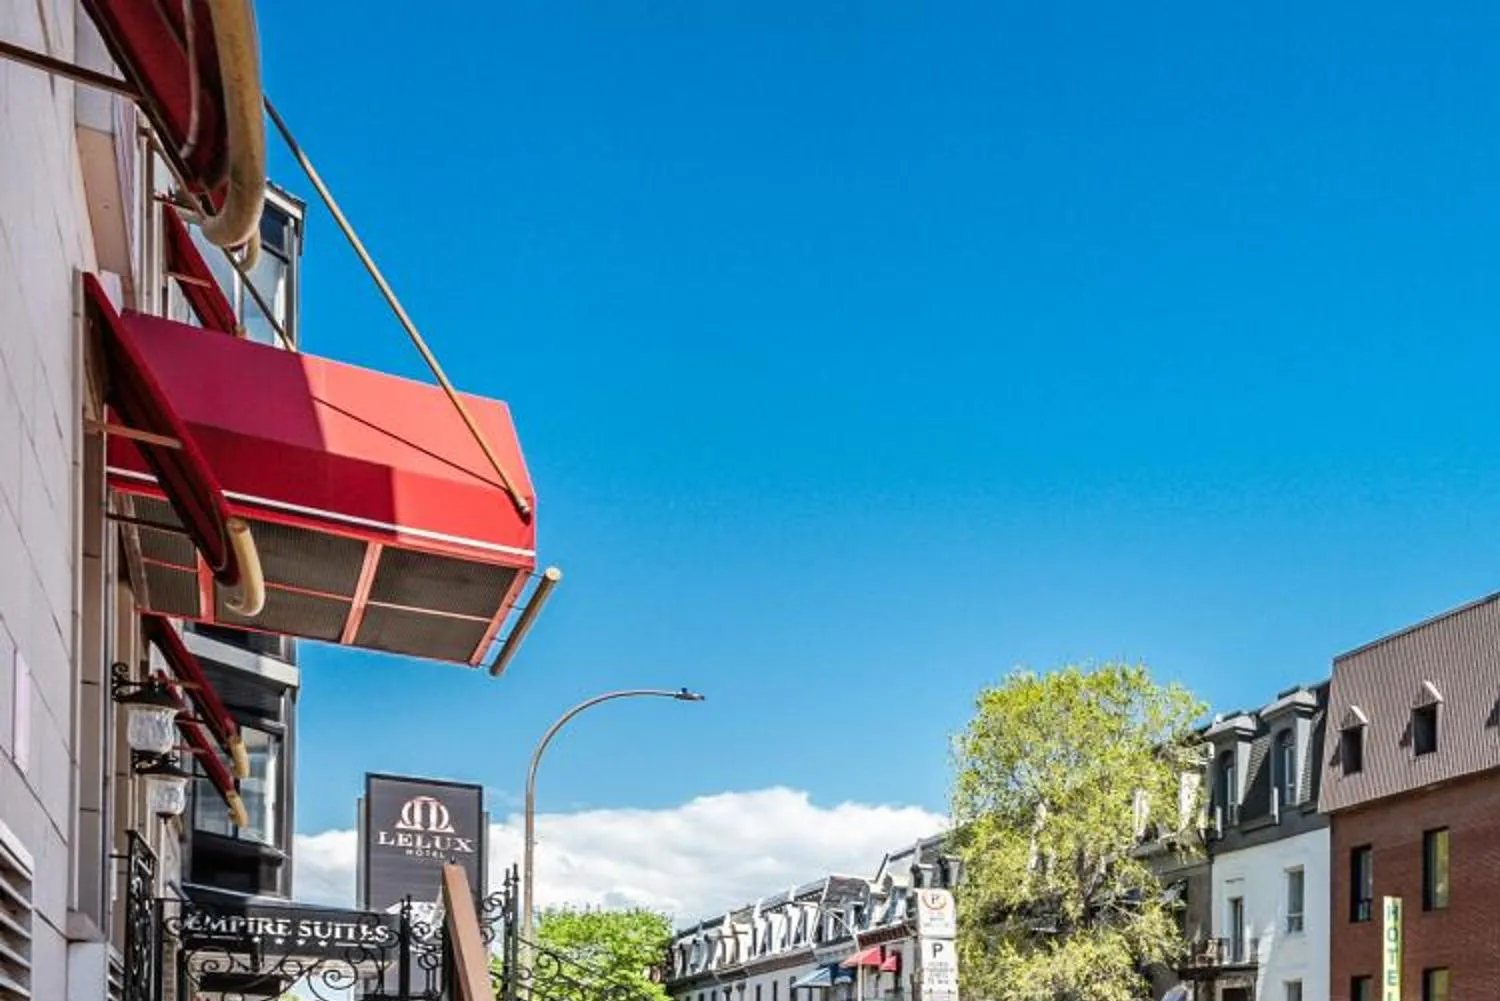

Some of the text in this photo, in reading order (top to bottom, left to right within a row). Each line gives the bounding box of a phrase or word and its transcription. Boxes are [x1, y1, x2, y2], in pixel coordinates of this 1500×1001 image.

[377, 831, 475, 853] LELUX
[405, 849, 446, 859] HOTEL
[187, 912, 389, 942] EMPIRE SUITES
